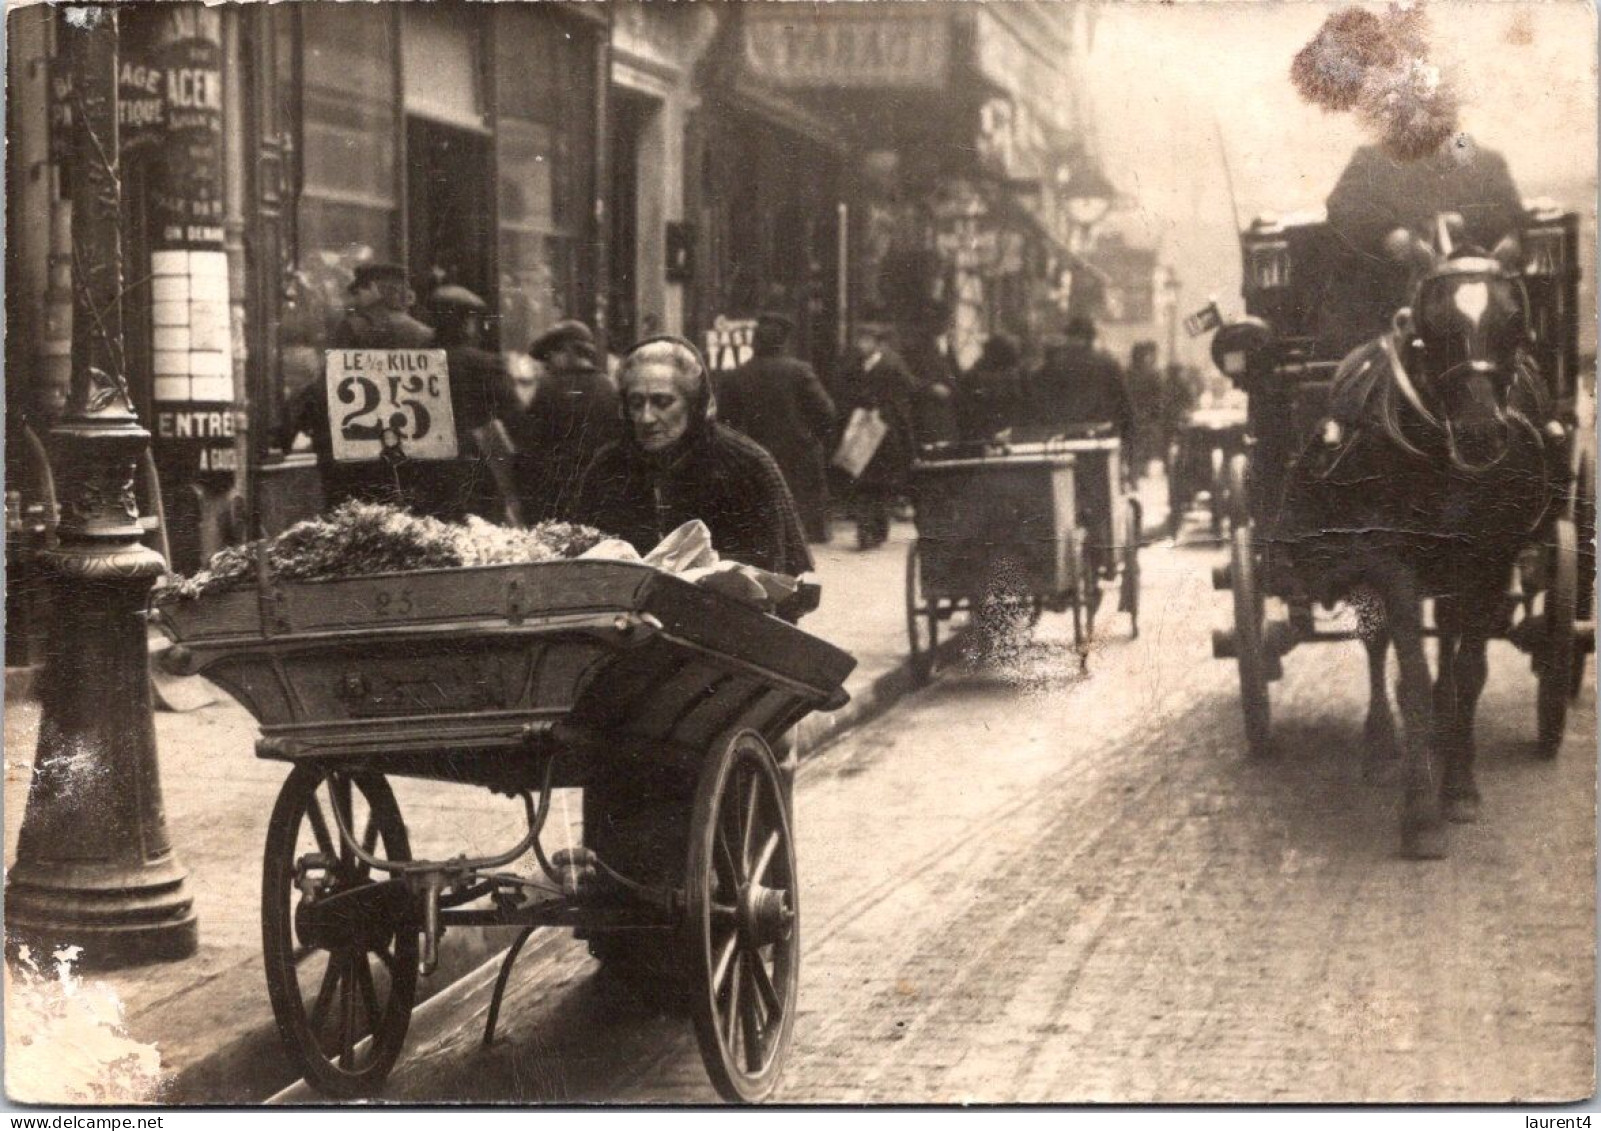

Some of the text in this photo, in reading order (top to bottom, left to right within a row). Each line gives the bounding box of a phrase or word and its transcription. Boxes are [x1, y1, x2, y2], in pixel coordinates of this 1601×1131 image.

[343, 353, 363, 370] LE
[388, 354, 428, 371] KILO
[337, 376, 431, 440] 25
